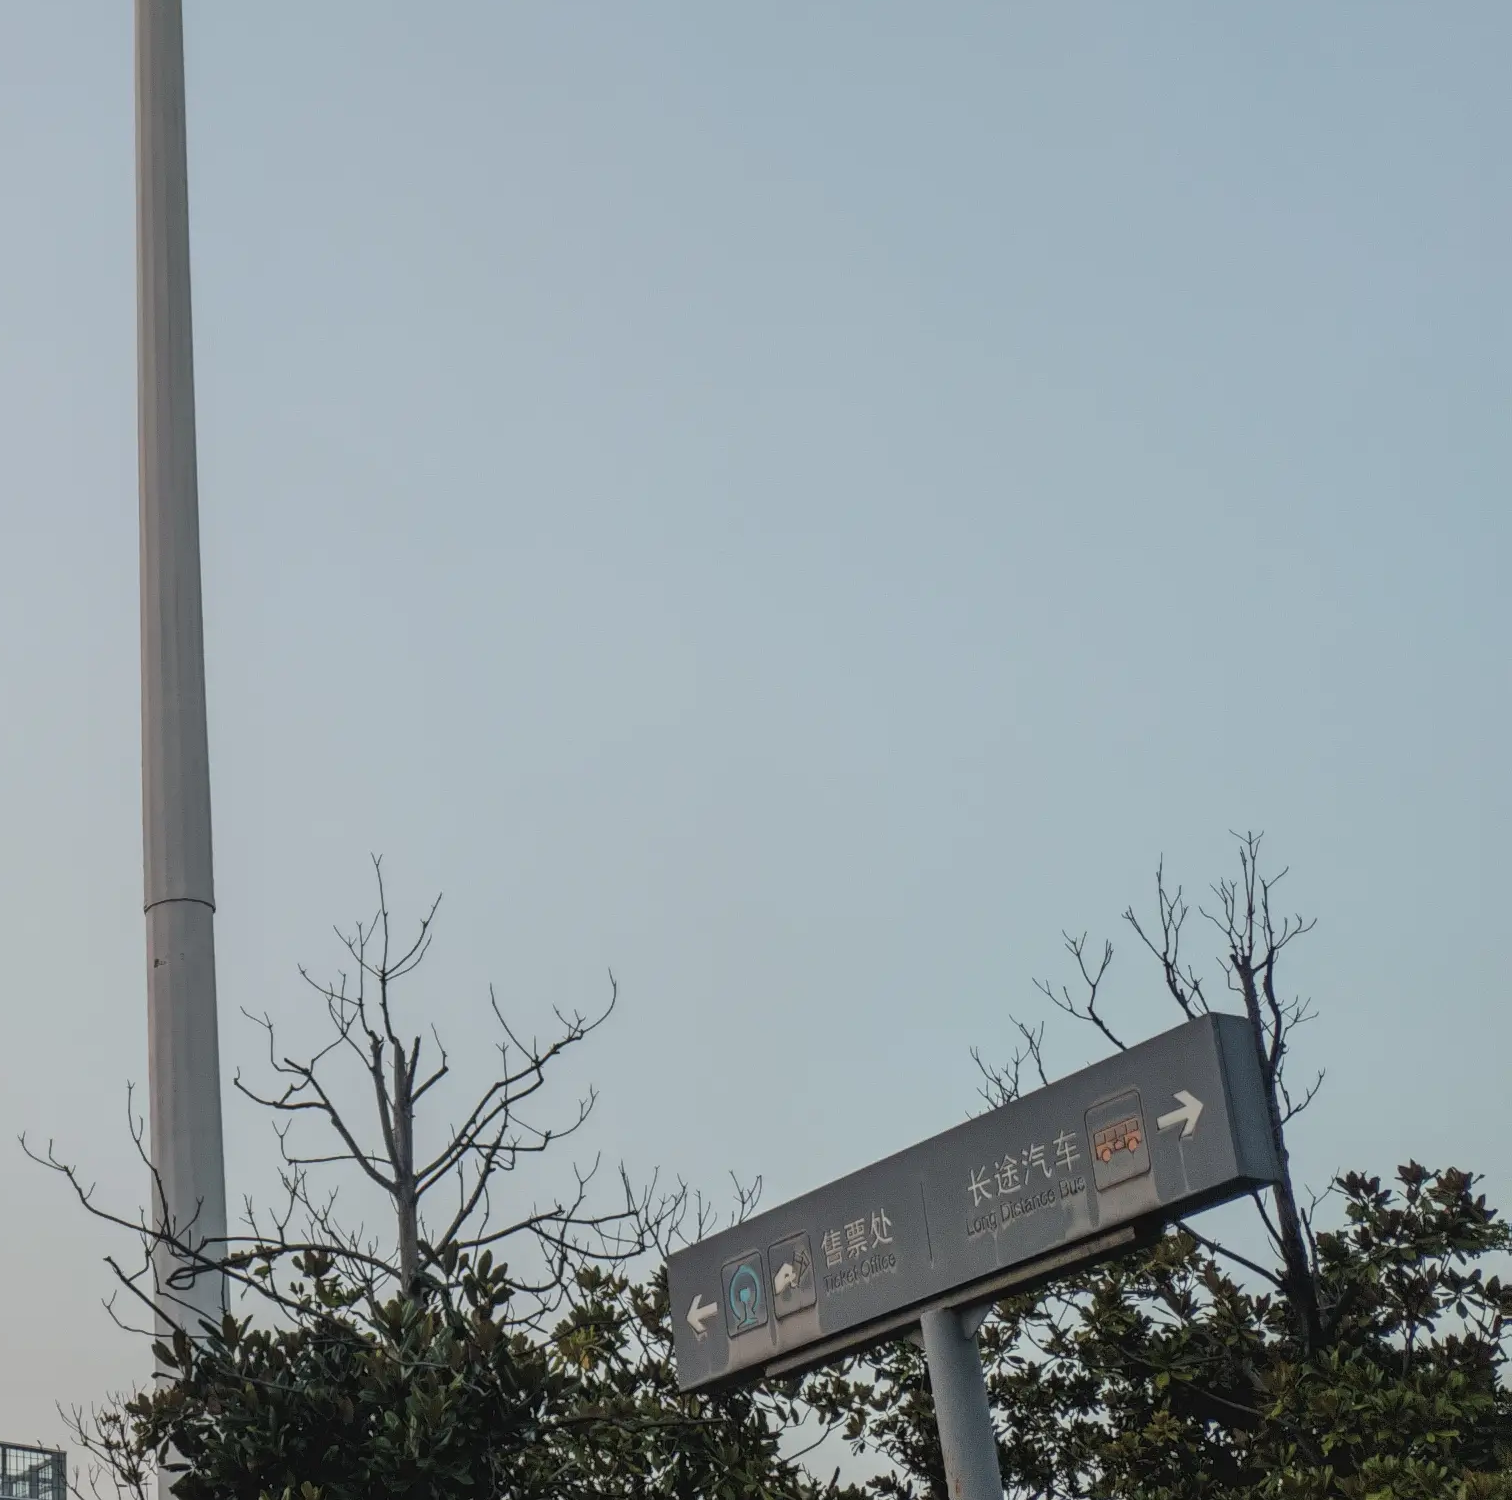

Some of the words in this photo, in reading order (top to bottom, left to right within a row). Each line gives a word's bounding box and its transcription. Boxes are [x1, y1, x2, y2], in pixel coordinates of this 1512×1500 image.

[967, 1128, 1081, 1208] 长途汽车
[966, 1211, 998, 1237] Long
[999, 1187, 1056, 1223] Distance
[1058, 1176, 1086, 1200] Bus
[820, 1207, 894, 1270] 售票处
[823, 1264, 858, 1292] Ticket
[860, 1252, 897, 1278] Office
